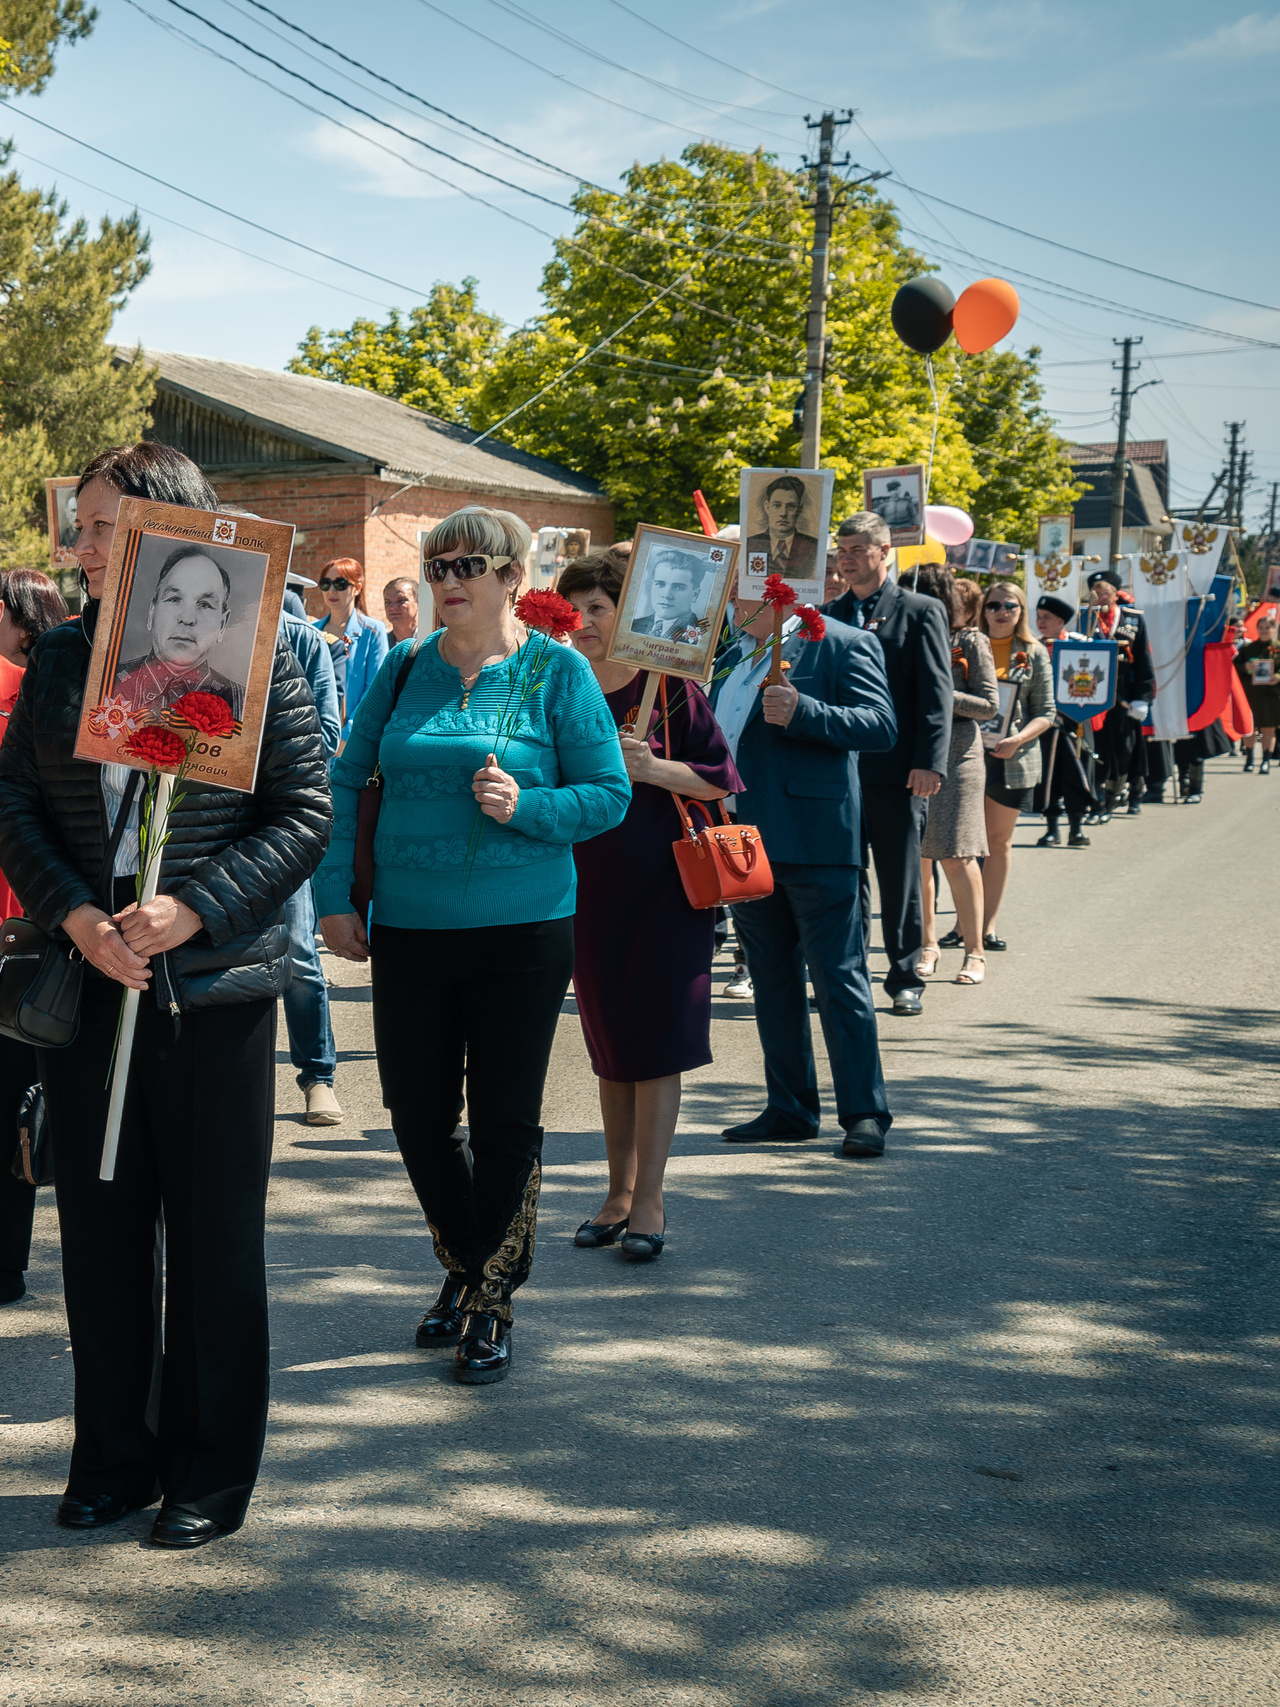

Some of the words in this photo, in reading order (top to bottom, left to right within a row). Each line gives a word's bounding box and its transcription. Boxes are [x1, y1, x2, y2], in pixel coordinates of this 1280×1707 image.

[622, 644, 645, 656] Иван
[646, 650, 697, 666] Андреевич
[643, 640, 680, 654] Чиграев
